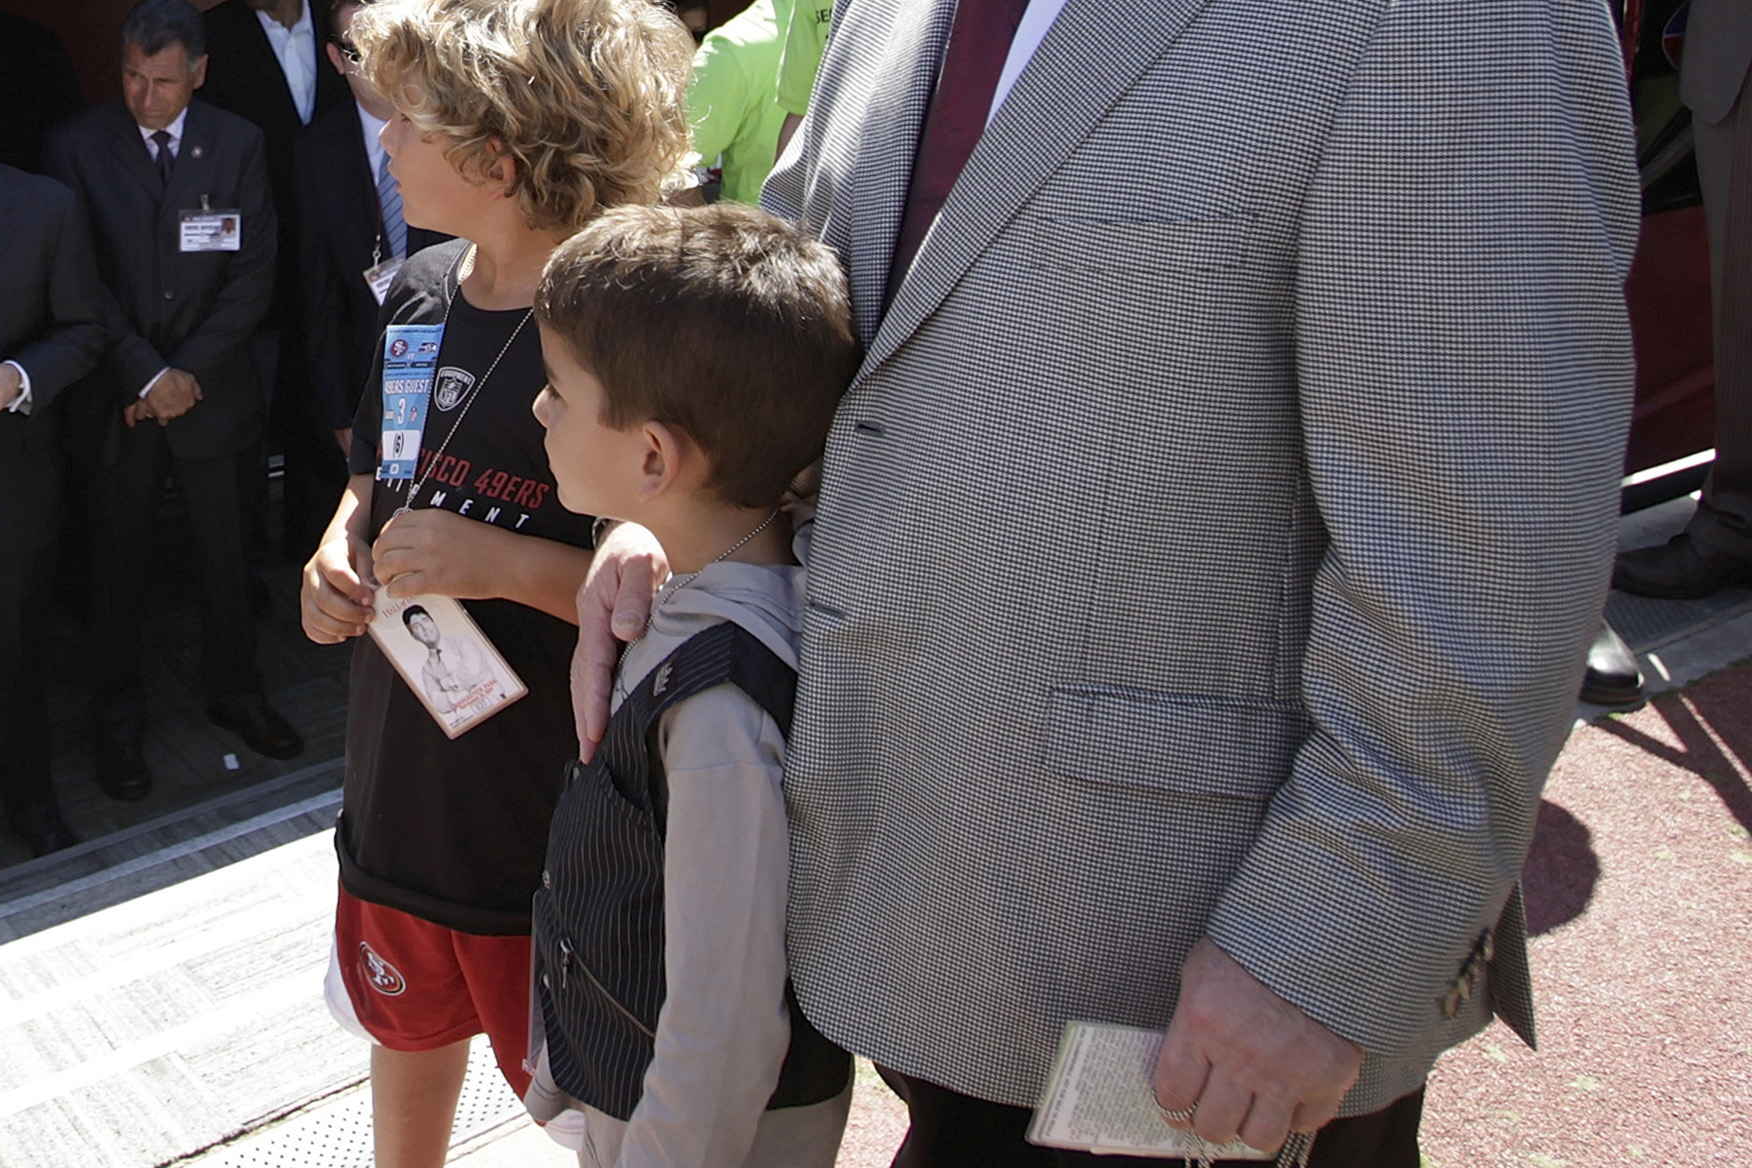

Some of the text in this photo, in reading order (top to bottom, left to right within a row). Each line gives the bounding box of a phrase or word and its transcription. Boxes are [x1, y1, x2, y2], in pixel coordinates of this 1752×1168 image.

[384, 378, 430, 395] 49ERS GUEST
[397, 397, 407, 426] 3
[473, 468, 551, 509] 49ERS
